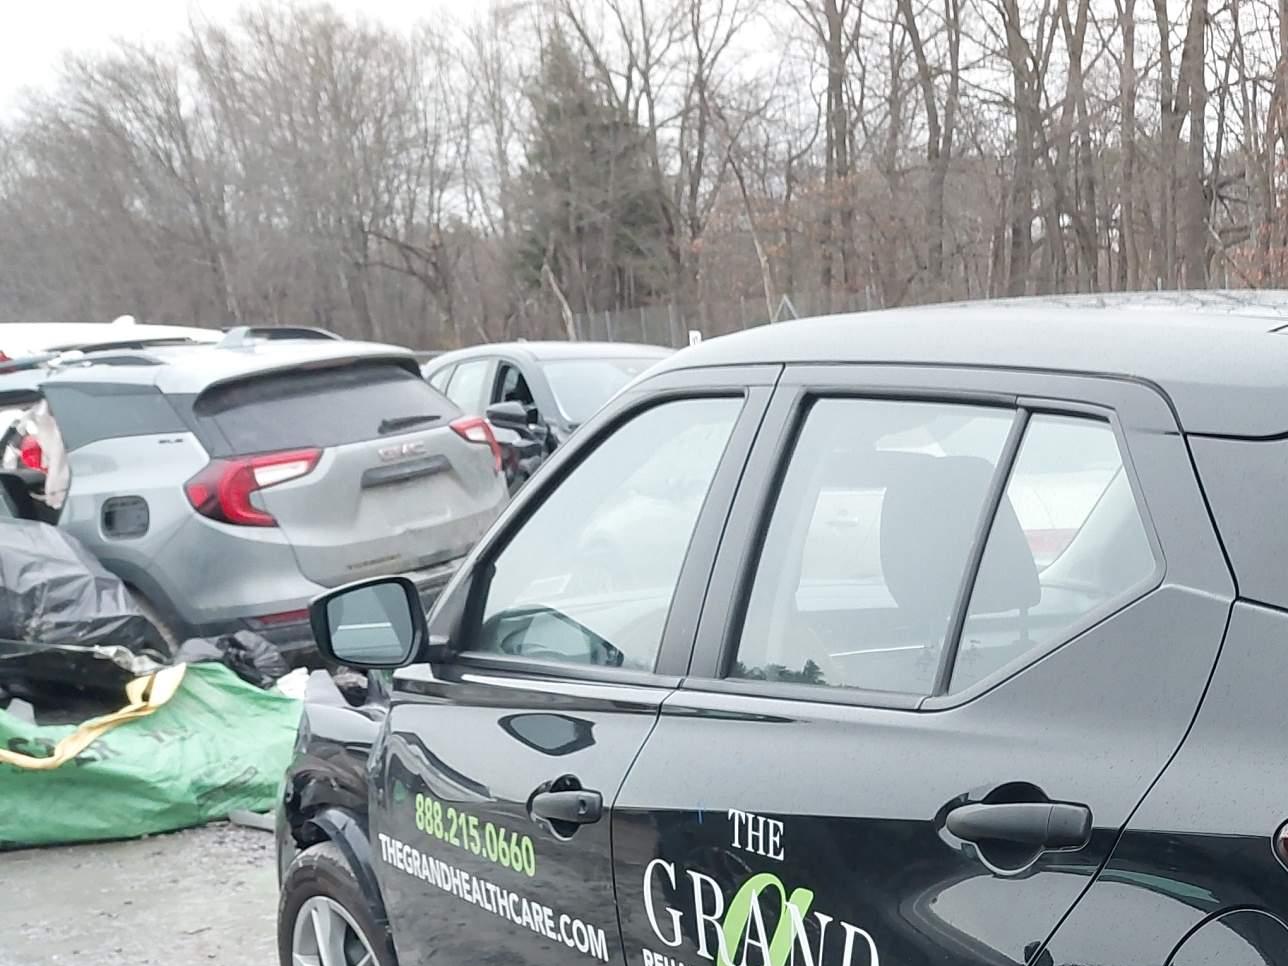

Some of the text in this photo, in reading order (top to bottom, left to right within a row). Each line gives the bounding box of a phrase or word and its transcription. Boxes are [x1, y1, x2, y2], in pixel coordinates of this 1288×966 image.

[416, 793, 536, 878] 888.215.0660
[728, 808, 785, 861] THE
[378, 832, 609, 963] THEGRANDHEALTHCARE.COM
